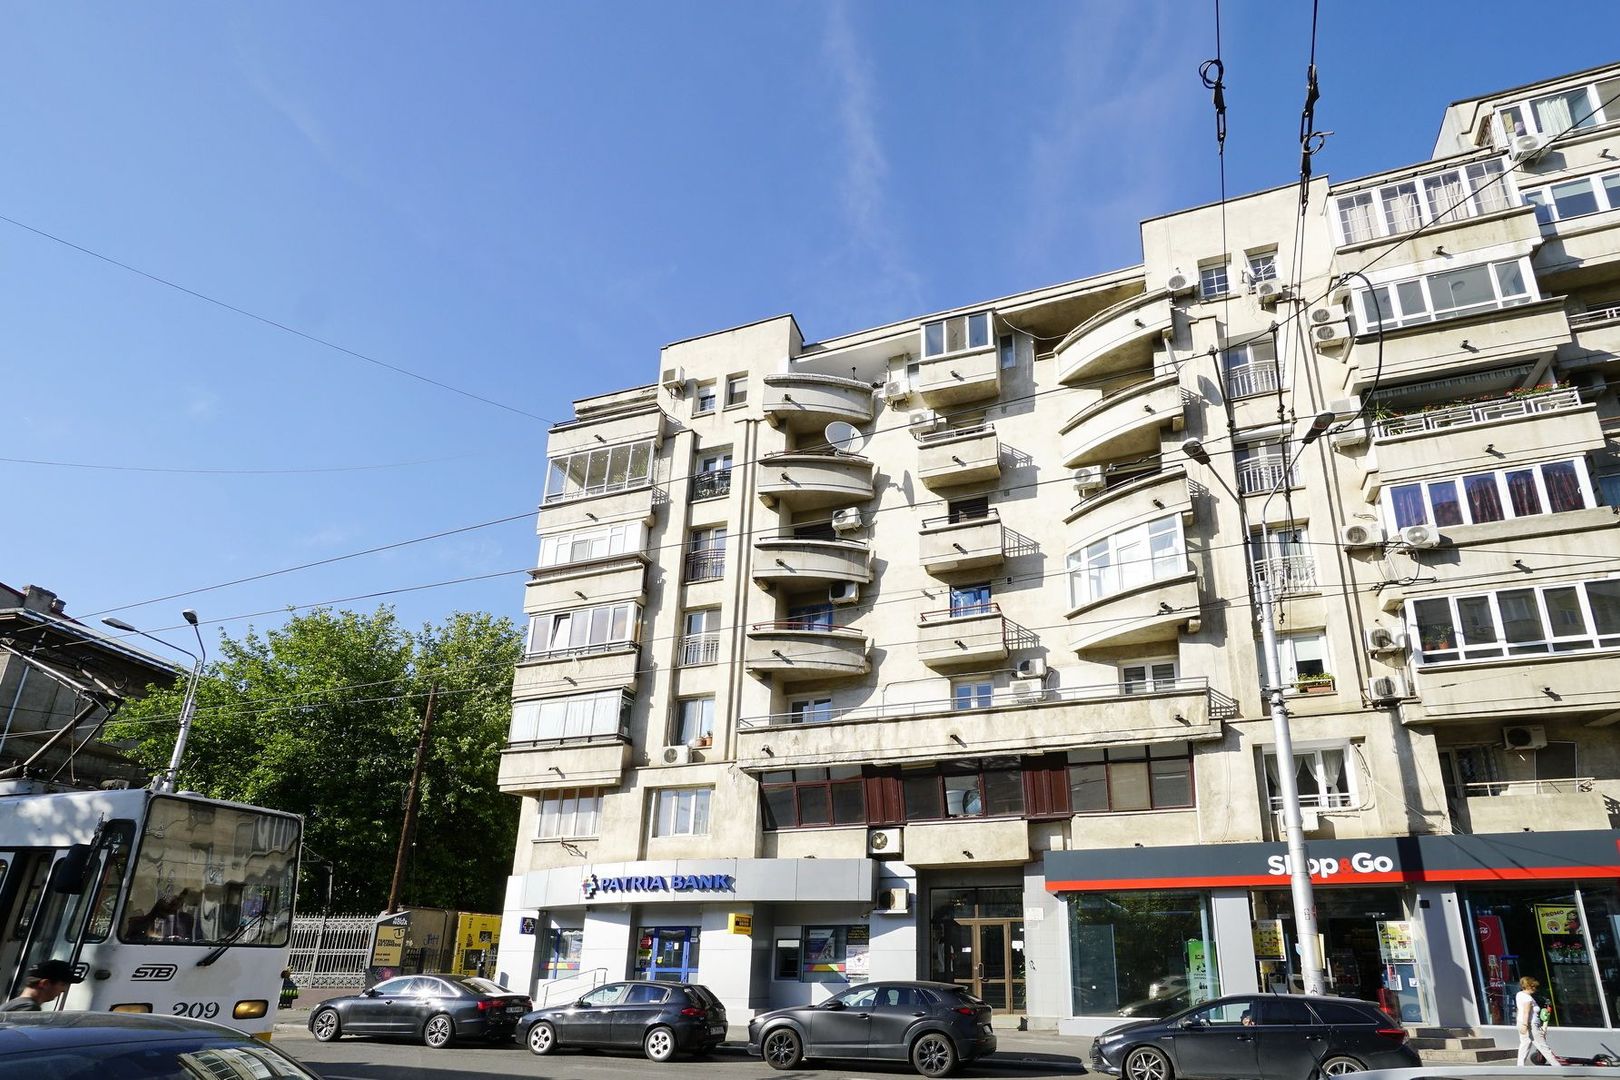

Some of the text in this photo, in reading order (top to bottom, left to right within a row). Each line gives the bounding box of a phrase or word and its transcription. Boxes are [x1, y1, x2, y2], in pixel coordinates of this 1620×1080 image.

[599, 875, 734, 892] PATRIA BANK
[131, 966, 174, 979] STB
[172, 1002, 220, 1018] 209
